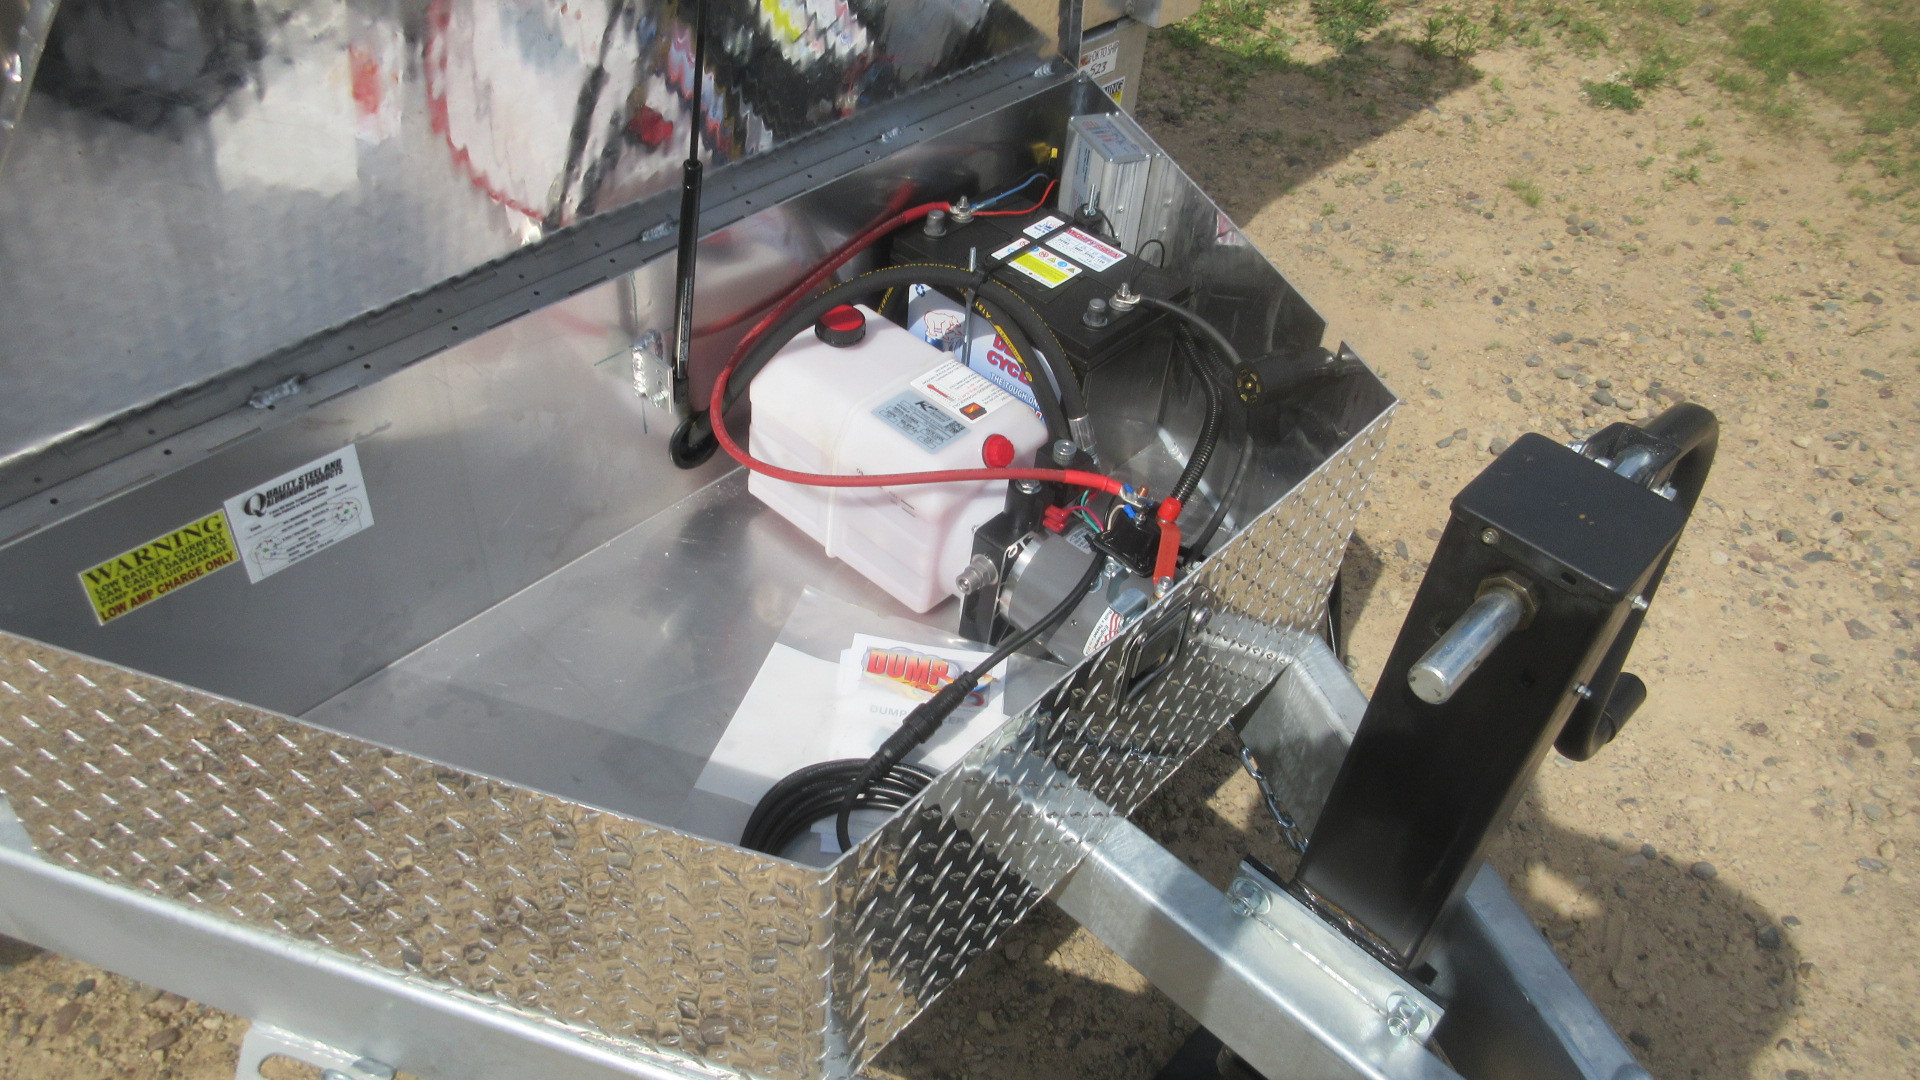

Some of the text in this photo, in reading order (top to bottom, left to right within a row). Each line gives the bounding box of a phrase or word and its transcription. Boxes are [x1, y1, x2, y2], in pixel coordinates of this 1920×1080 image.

[990, 373, 1004, 386] THE
[1004, 380, 1028, 400] TOUGH
[266, 482, 305, 507] ALUMINUM
[305, 464, 343, 489] PRODUCTS
[298, 466, 322, 484] STEEL
[323, 457, 342, 472] AND
[86, 515, 223, 586] WARNING
[94, 531, 223, 593] LOW BATTERY CURRENT
[97, 537, 226, 600] CAN CAUSE DAMAGE TO
[100, 544, 228, 608] PUMP AND FLUID LEAKAGE
[100, 550, 234, 621] LOW AMP CHARGE ONLY
[866, 649, 952, 685] DUMP
